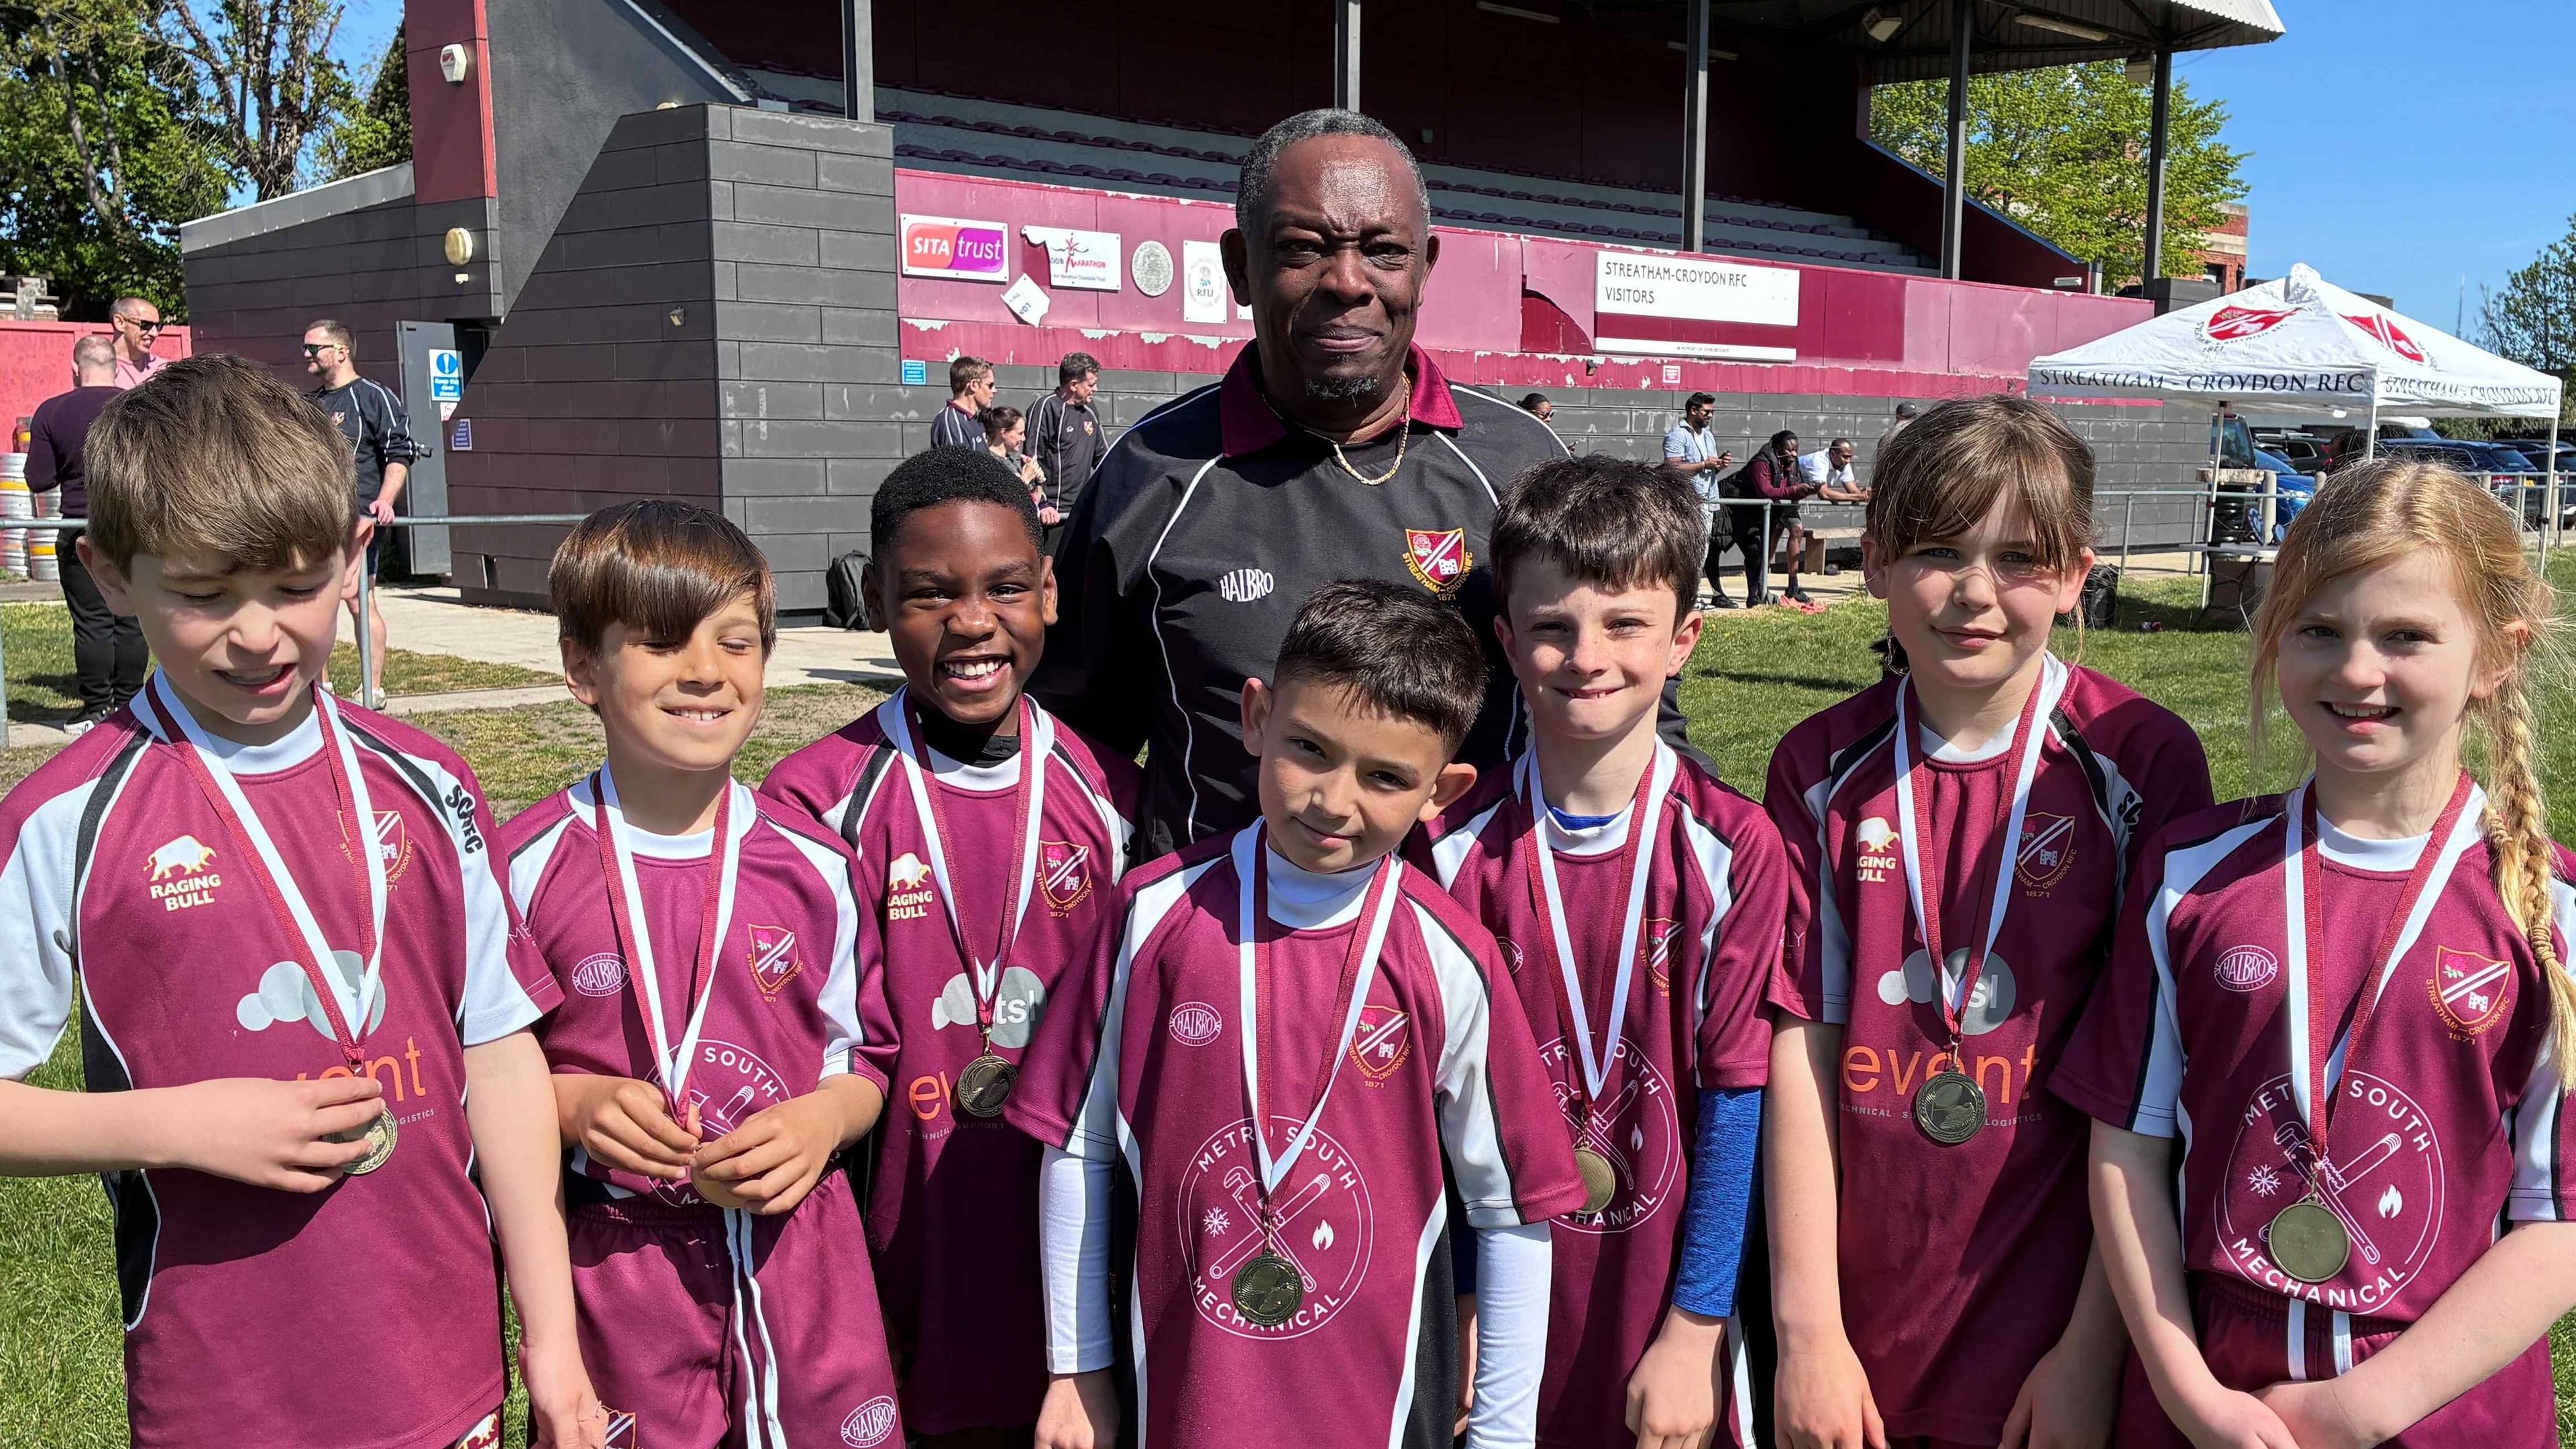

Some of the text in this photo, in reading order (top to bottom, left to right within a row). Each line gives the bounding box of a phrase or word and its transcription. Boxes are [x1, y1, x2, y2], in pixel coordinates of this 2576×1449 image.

[914, 236, 1002, 260] SITA trust
[1605, 262, 1748, 287] STREATHAM-CROYDON RFC
[1605, 286, 1654, 304] VISITORS
[2186, 374, 2308, 390] CROYDON
[2318, 374, 2365, 392] RFC
[1220, 568, 1274, 602] HALBRO
[1858, 855, 1896, 869] GING
[150, 874, 221, 900] RAGING
[1857, 869, 1886, 882] ULL
[164, 890, 215, 912] BULL
[890, 904, 928, 920] BULL
[581, 961, 621, 989] HALBRO
[2223, 955, 2266, 981] HALBRO
[1968, 975, 1998, 1008] sl
[996, 989, 1036, 1024] tsl
[2426, 979, 2458, 1030] STREATHAM
[2469, 1012, 2502, 1035] CROYDON
[2499, 996, 2510, 1014] RFC
[1177, 1012, 1213, 1036] HALBRO
[2448, 1032, 2475, 1044] 1871
[704, 1046, 779, 1097] SOUTH
[1379, 1056, 1406, 1080] CROYDON
[1614, 1043, 1661, 1095] OUTH
[399, 1108, 435, 1125] GISTICS
[1840, 1102, 1892, 1117] ECHNICAL
[1985, 1112, 2043, 1127] LOGISTICS
[2245, 1079, 2431, 1152] MET SOUTH
[1198, 1126, 1274, 1173] METR
[1560, 1194, 1657, 1227] HANICAL
[2233, 1237, 2406, 1307] MECHANICAL
[853, 1406, 890, 1438] HALBRO
